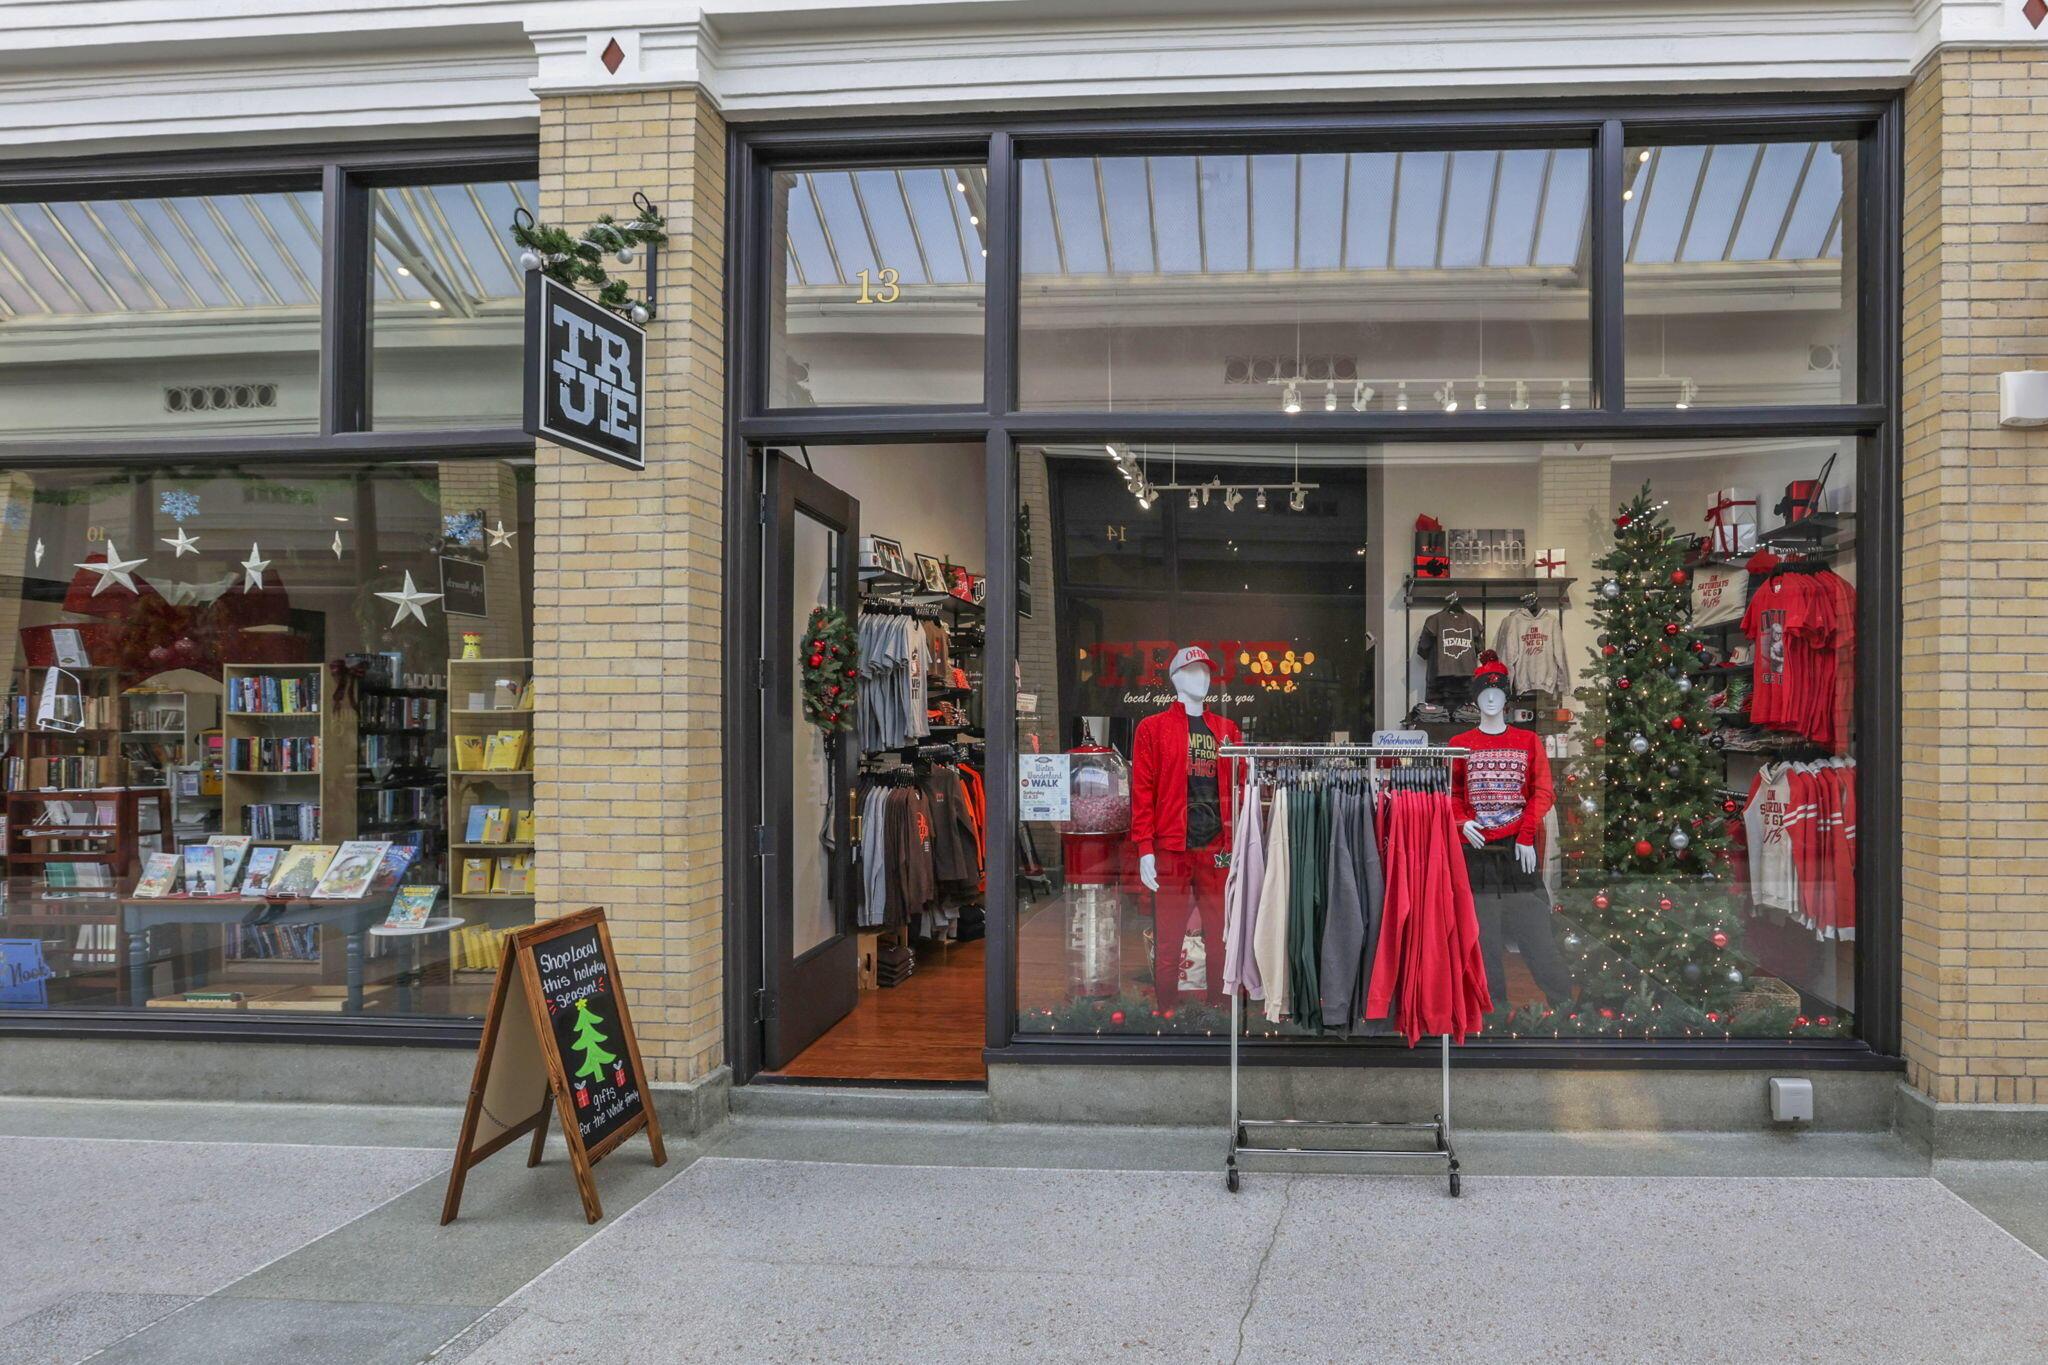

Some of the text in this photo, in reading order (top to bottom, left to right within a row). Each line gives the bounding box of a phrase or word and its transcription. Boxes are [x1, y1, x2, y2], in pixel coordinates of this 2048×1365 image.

[856, 267, 901, 304] 13
[1443, 637, 1472, 648] NEWARK
[403, 672, 448, 690] ADUL
[1124, 692, 1151, 703] local
[1221, 693, 1232, 703] to
[1235, 694, 1255, 706] you
[1377, 733, 1425, 745] Knockaround
[1031, 779, 1059, 788] WALK
[540, 938, 598, 974] Shop Local
[542, 959, 607, 994] this holiday
[593, 1086, 617, 1112] gifts
[579, 1122, 591, 1138] for
[592, 1112, 606, 1129] the
